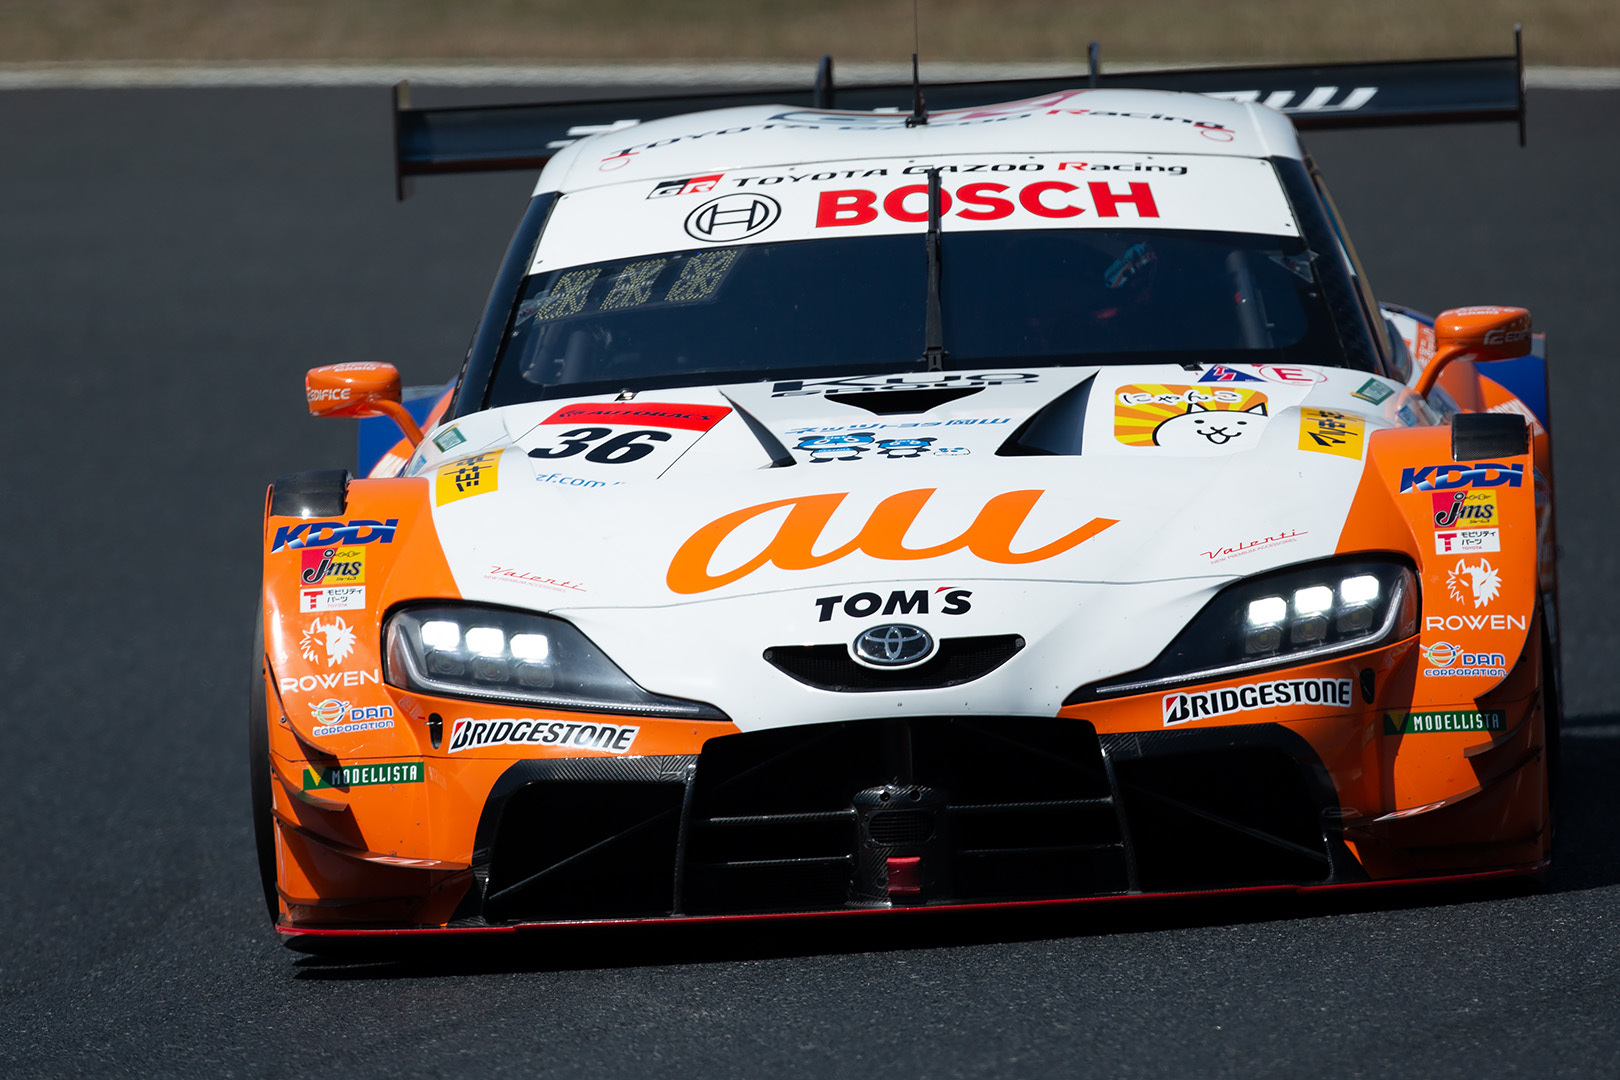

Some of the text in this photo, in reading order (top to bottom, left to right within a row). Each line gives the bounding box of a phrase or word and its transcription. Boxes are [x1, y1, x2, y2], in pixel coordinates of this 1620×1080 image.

[732, 168, 888, 187] TOYOTA
[1057, 161, 1189, 176] Racing
[815, 180, 1161, 228] BOSCH
[527, 427, 672, 465] 36
[1400, 463, 1524, 494] KDDI
[1434, 491, 1494, 527] jms
[270, 519, 399, 554] KDDI
[665, 487, 1121, 595] au
[1461, 530, 1496, 538] モビリティ
[1461, 538, 1482, 546] パーツ
[302, 549, 363, 584] jms
[327, 588, 363, 596] モビリティ
[814, 586, 973, 622] TOM'S
[1425, 615, 1526, 631] ROWEN
[1462, 652, 1506, 667] DAN
[280, 668, 380, 695] ROWEN
[1424, 668, 1507, 678] CORPORATION
[350, 704, 394, 722] DAN
[1164, 679, 1351, 724] BRIDGESTONE
[312, 720, 395, 737] CORPORATION
[1413, 712, 1500, 731] MODELLISTA
[449, 719, 638, 752] BRIDGESTONE
[331, 765, 418, 785] MODELLISTA
